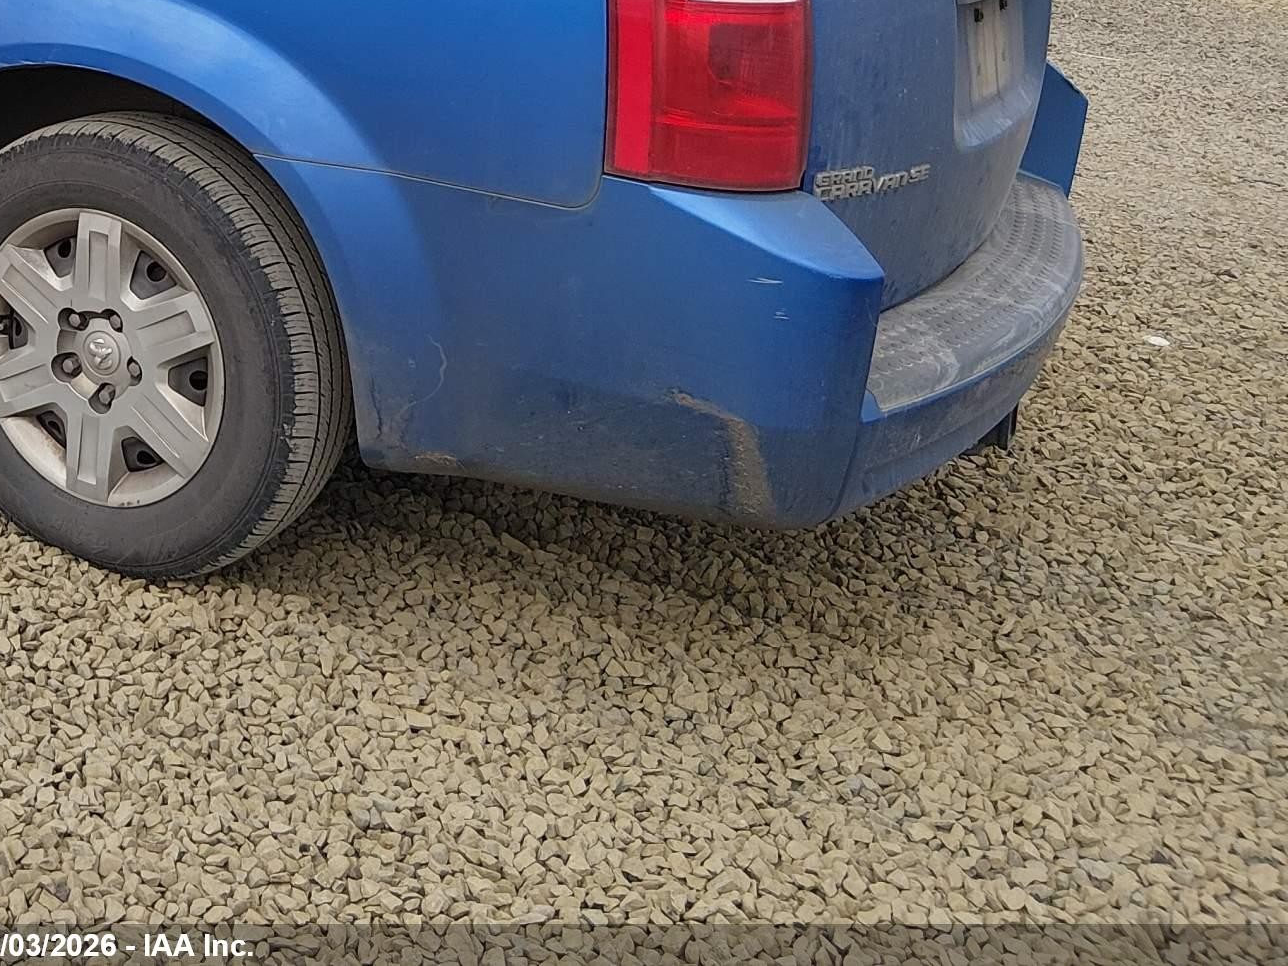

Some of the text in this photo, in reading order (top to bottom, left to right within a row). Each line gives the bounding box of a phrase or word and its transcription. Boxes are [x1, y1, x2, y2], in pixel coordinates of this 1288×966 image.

[815, 165, 874, 187] GRAND
[816, 164, 931, 201] CARAVAN SE
